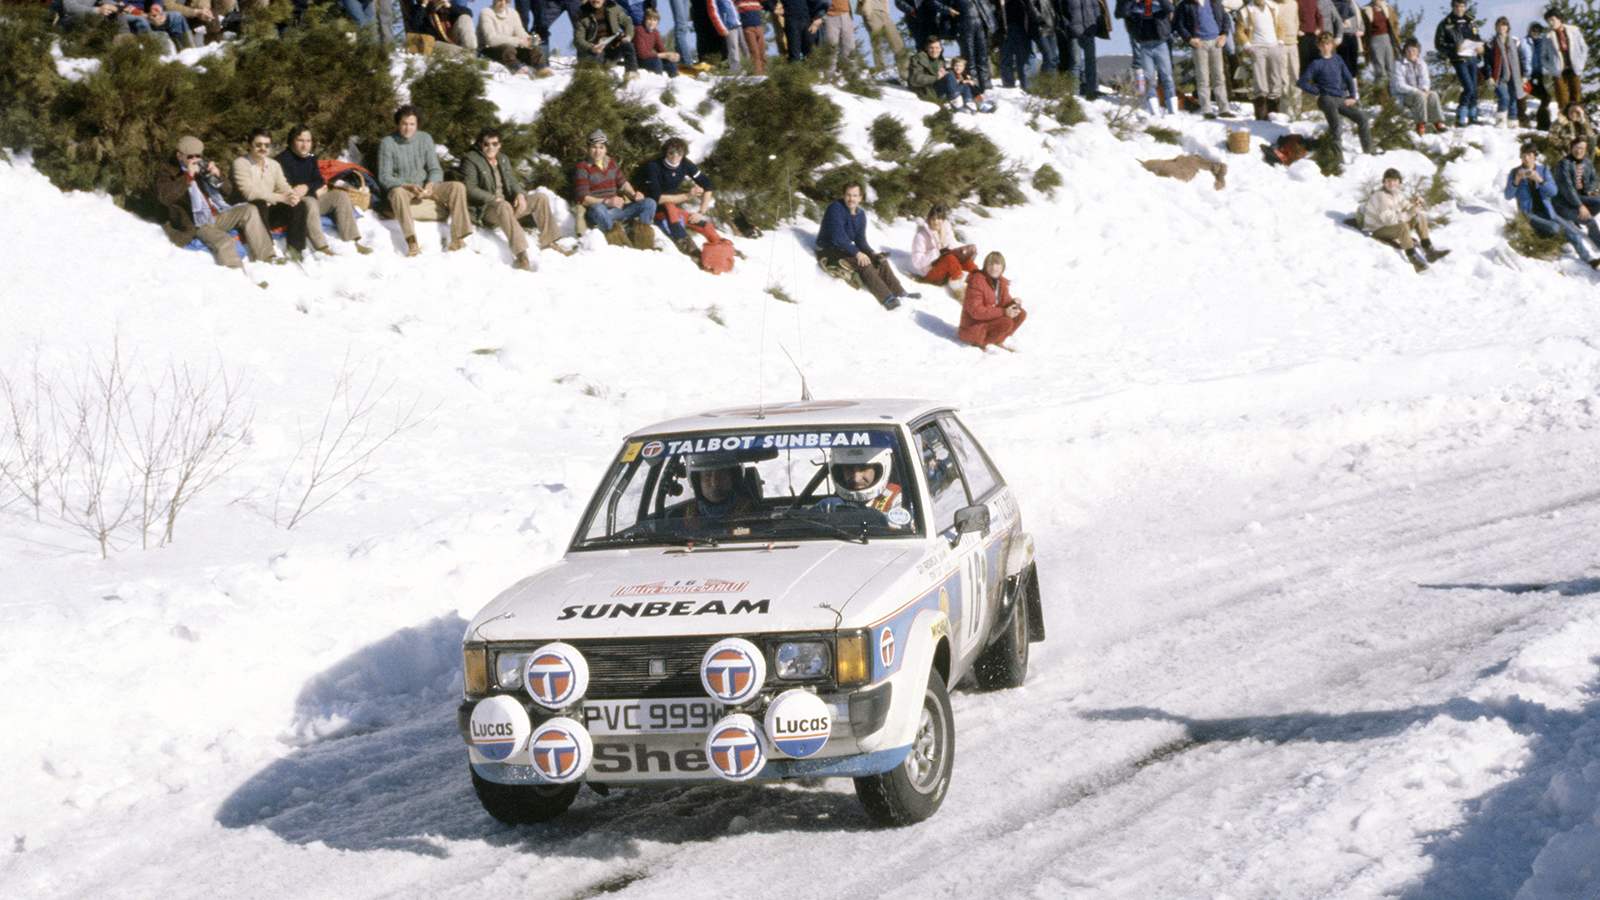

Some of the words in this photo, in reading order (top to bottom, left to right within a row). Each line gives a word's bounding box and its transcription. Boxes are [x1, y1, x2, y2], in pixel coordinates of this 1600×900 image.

[667, 436, 756, 455] TALBOT
[762, 432, 871, 448] SUNBEAM
[619, 585, 660, 596] RALLYE
[556, 599, 771, 620] SUNBEAM
[472, 718, 513, 738] Lucas
[584, 704, 642, 731] PVC
[775, 713, 828, 735] Lucas
[592, 743, 711, 773] She
